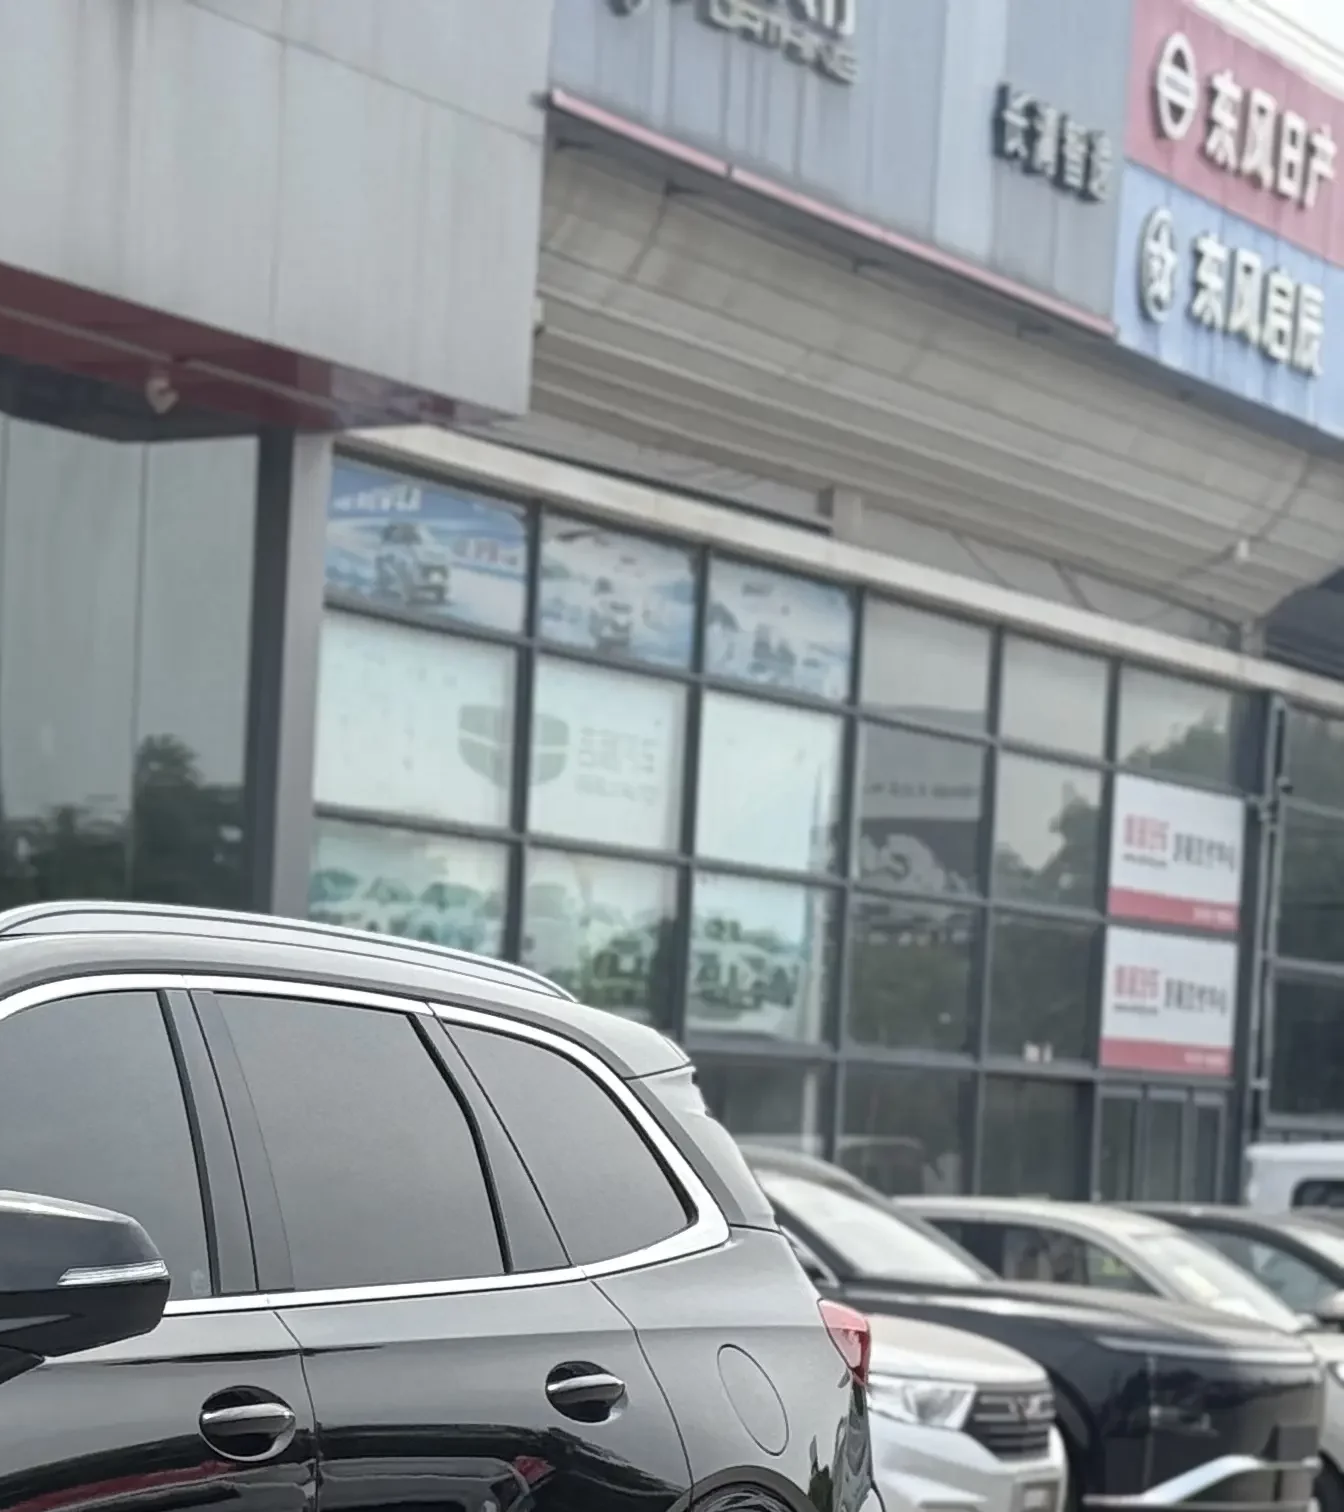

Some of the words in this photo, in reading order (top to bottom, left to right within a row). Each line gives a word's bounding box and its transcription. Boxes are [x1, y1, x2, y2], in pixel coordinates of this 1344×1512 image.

[1204, 69, 1337, 208] 东风日产
[1190, 234, 1326, 376] 东风启辰
